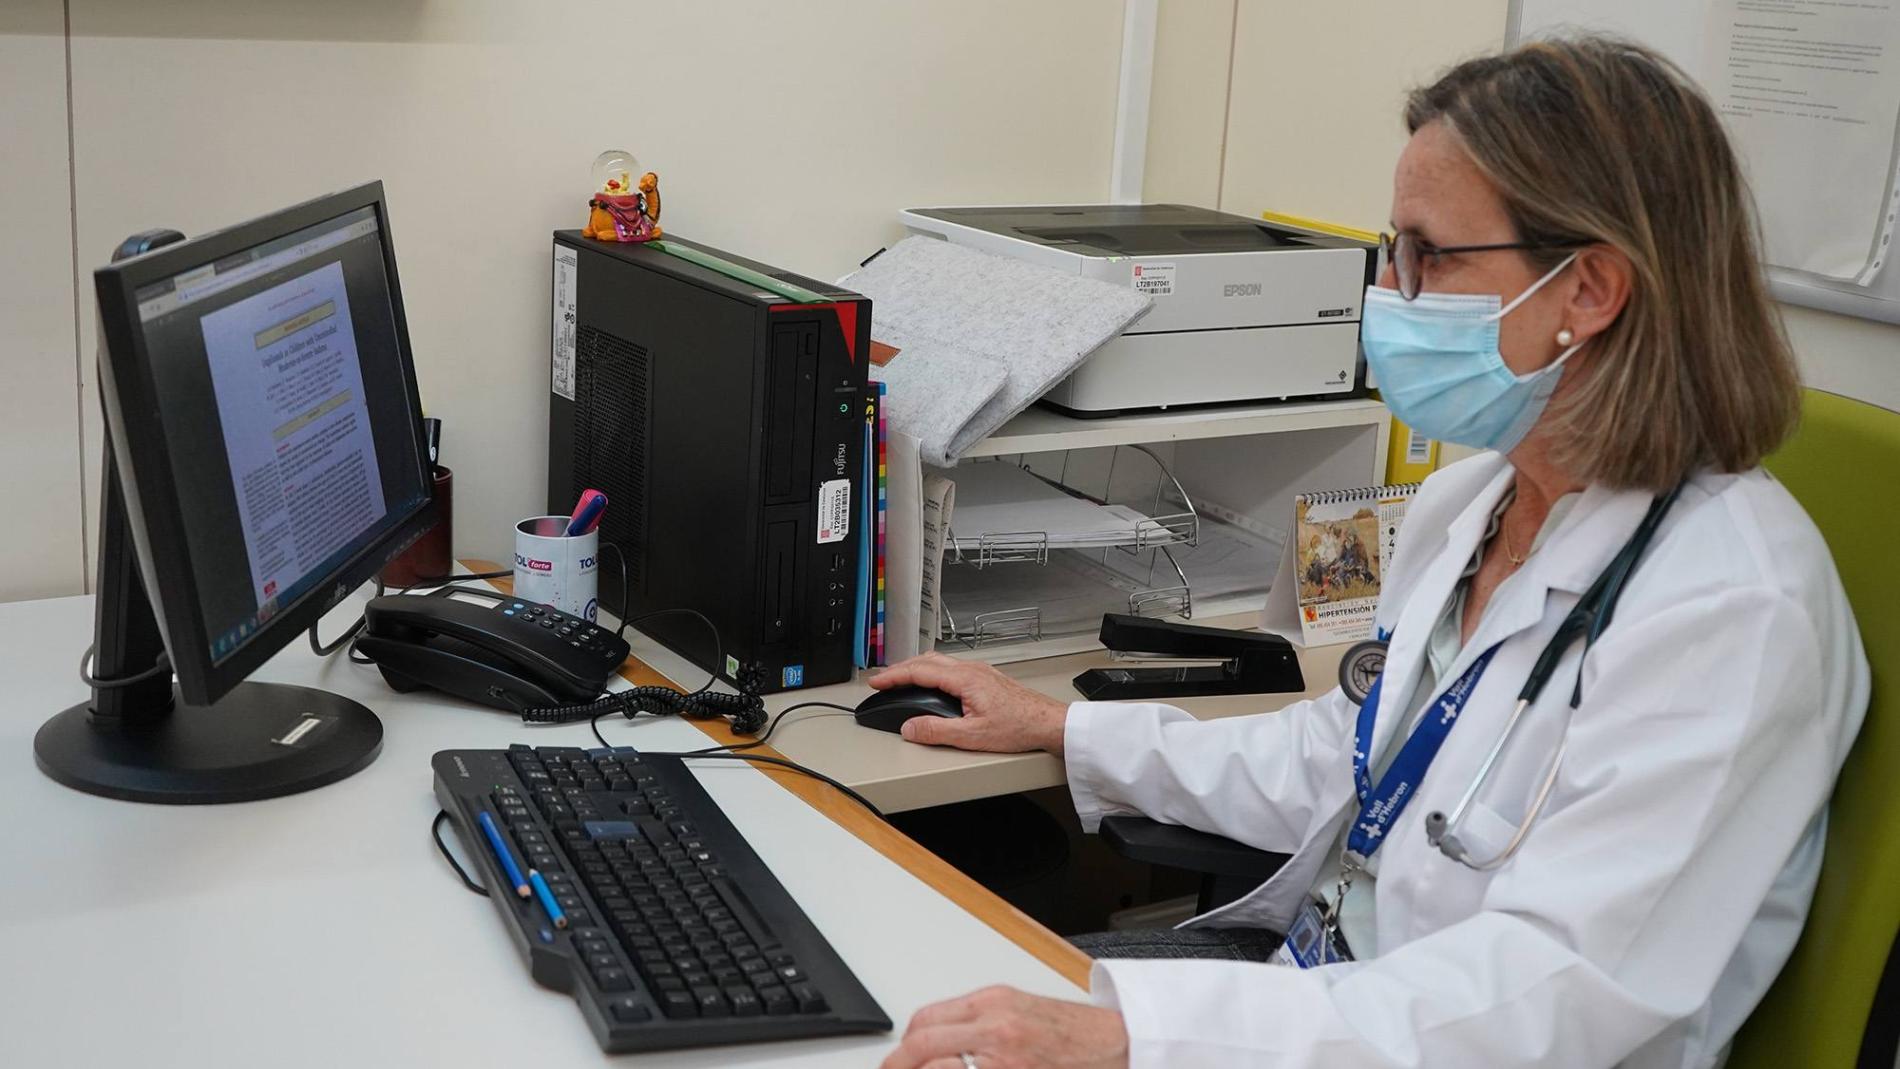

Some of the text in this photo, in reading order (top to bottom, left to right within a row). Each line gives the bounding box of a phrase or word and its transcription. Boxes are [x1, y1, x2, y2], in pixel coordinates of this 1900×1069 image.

[1224, 282, 1262, 297] EPSON
[834, 443, 847, 475] FUJITSU
[530, 561, 550, 569] forte
[1318, 605, 1370, 619] HIPERTENSIÓN
[1366, 799, 1384, 819] Vall
[1377, 781, 1408, 823] d'Hebron
